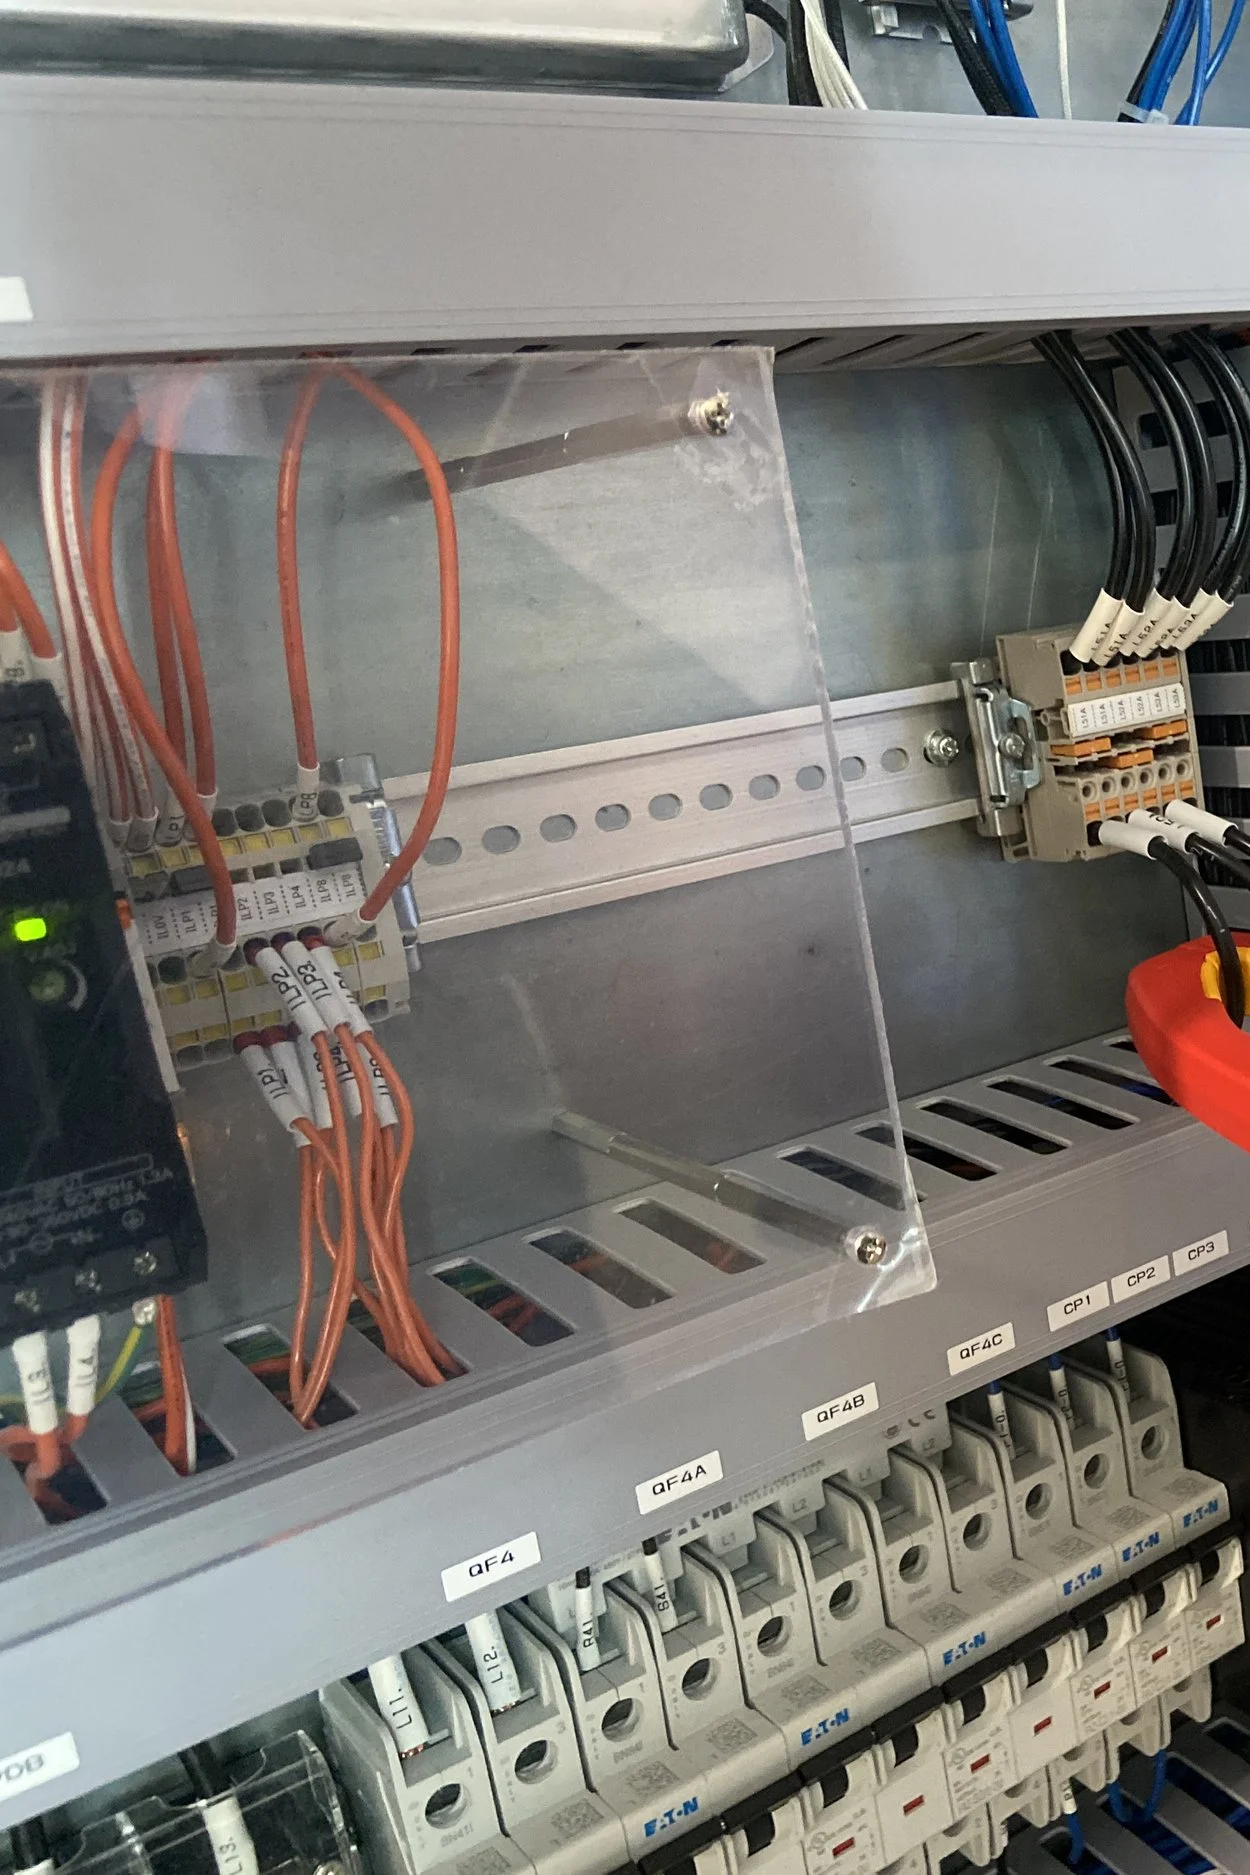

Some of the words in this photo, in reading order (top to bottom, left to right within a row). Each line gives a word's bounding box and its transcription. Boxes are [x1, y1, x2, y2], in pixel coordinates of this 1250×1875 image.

[1187, 1240, 1216, 1262] CP3
[1127, 1266, 1156, 1288] CP2
[1063, 1294, 1091, 1316] CP1
[959, 1332, 1004, 1361] QF4C
[816, 1393, 866, 1424] QF4B
[651, 1463, 708, 1496] QF4A
[468, 1548, 517, 1581] QF4
